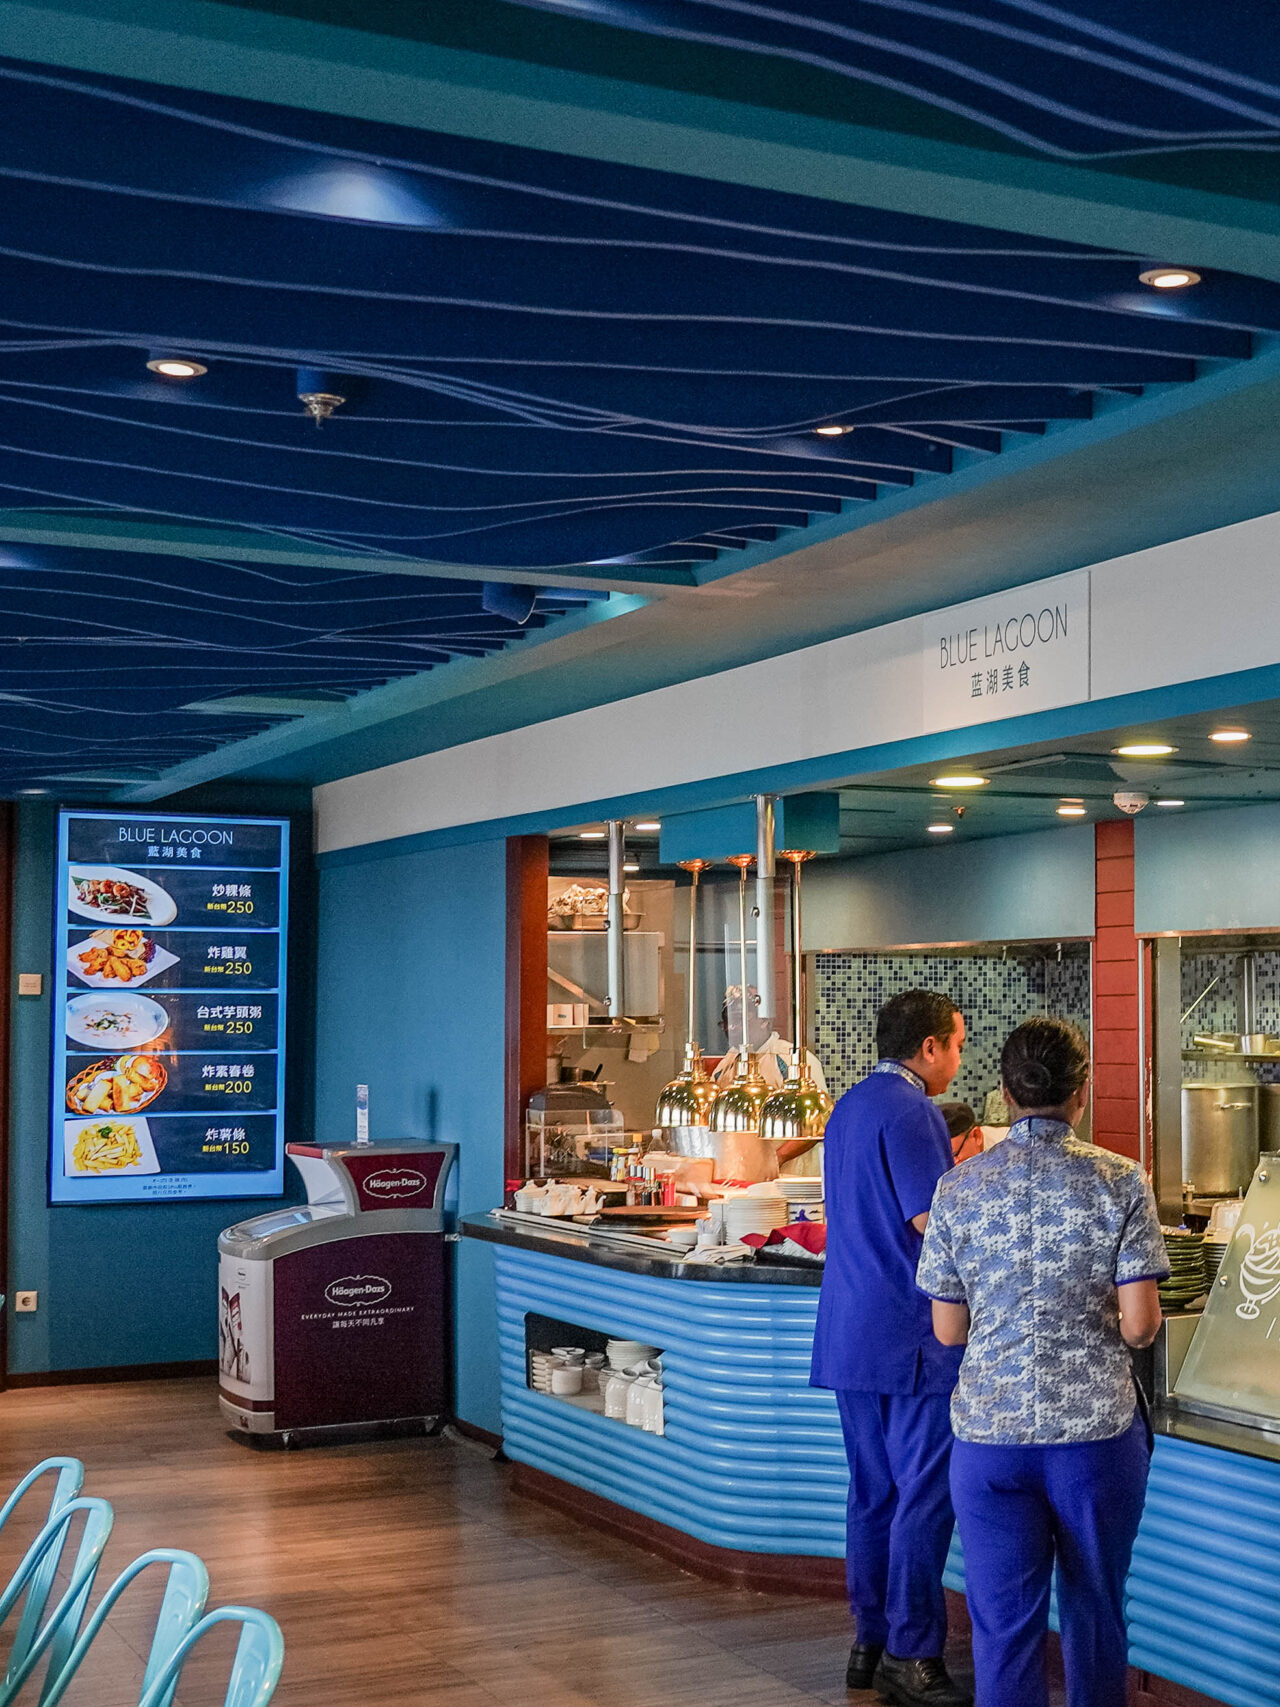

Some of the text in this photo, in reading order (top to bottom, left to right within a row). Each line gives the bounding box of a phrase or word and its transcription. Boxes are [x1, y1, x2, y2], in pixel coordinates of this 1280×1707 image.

[940, 603, 1068, 669] BLUE LAGOON
[971, 660, 1031, 698] 蓝湖美食
[119, 827, 233, 845] BLUE LAGOON
[147, 845, 202, 858] 藍湖美食
[196, 1005, 262, 1019] 台式芋頭粥
[370, 1178, 420, 1190] Häagen-Dazs
[332, 1285, 385, 1297] Häagen-Dazs
[301, 1312, 335, 1320] EVERYDAY
[359, 1306, 415, 1316] EXTRAORDINARY
[1265, 1317, 1277, 1339] I
